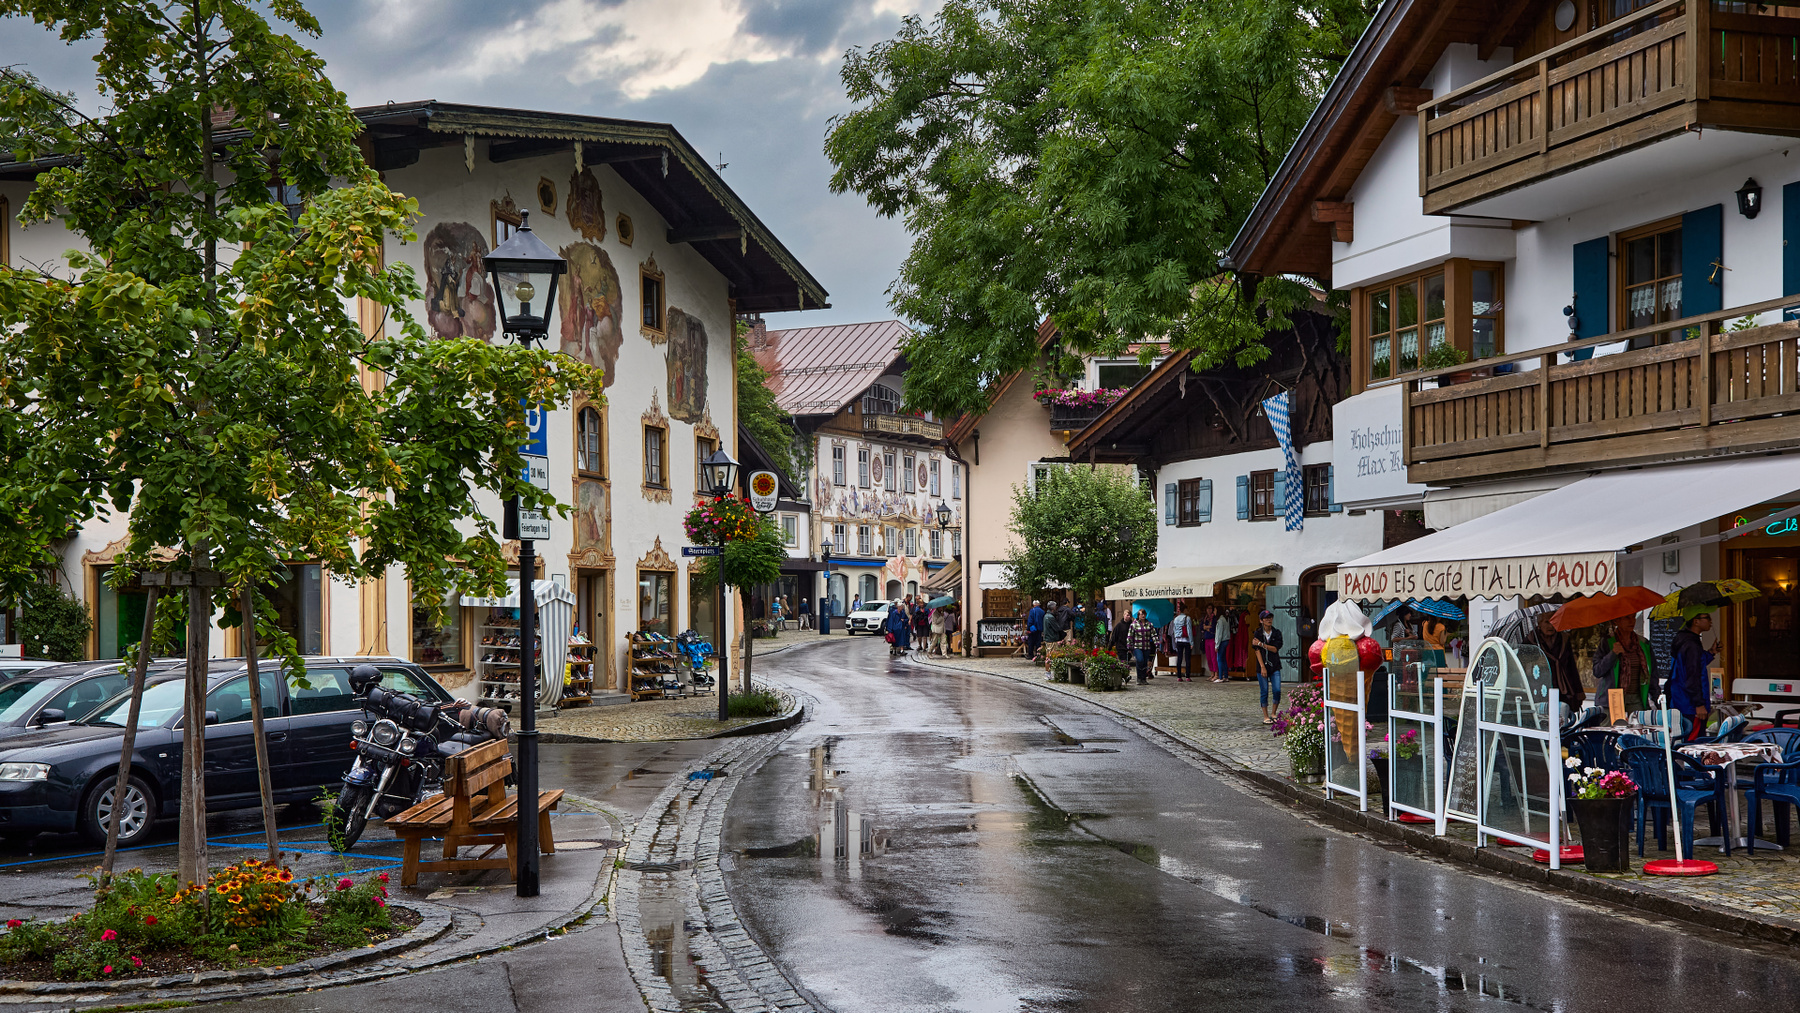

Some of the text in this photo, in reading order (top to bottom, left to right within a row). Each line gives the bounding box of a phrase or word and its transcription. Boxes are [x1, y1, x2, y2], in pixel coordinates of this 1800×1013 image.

[526, 404, 541, 451] P
[1350, 424, 1402, 453] Holzschni
[1357, 455, 1386, 478] Max
[530, 467, 547, 480] 30 Min.
[522, 512, 528, 520] an
[521, 522, 541, 535] Feiertagen
[1344, 571, 1388, 595] PAOLO
[1394, 567, 1416, 593] Eis
[1471, 563, 1541, 591] ITALIA
[1546, 560, 1609, 588] PAOLO
[1121, 588, 1138, 598] Textil-
[1139, 588, 1145, 597] &
[1145, 586, 1182, 597] Souvenirhaus
[984, 624, 1009, 633] Nativity
